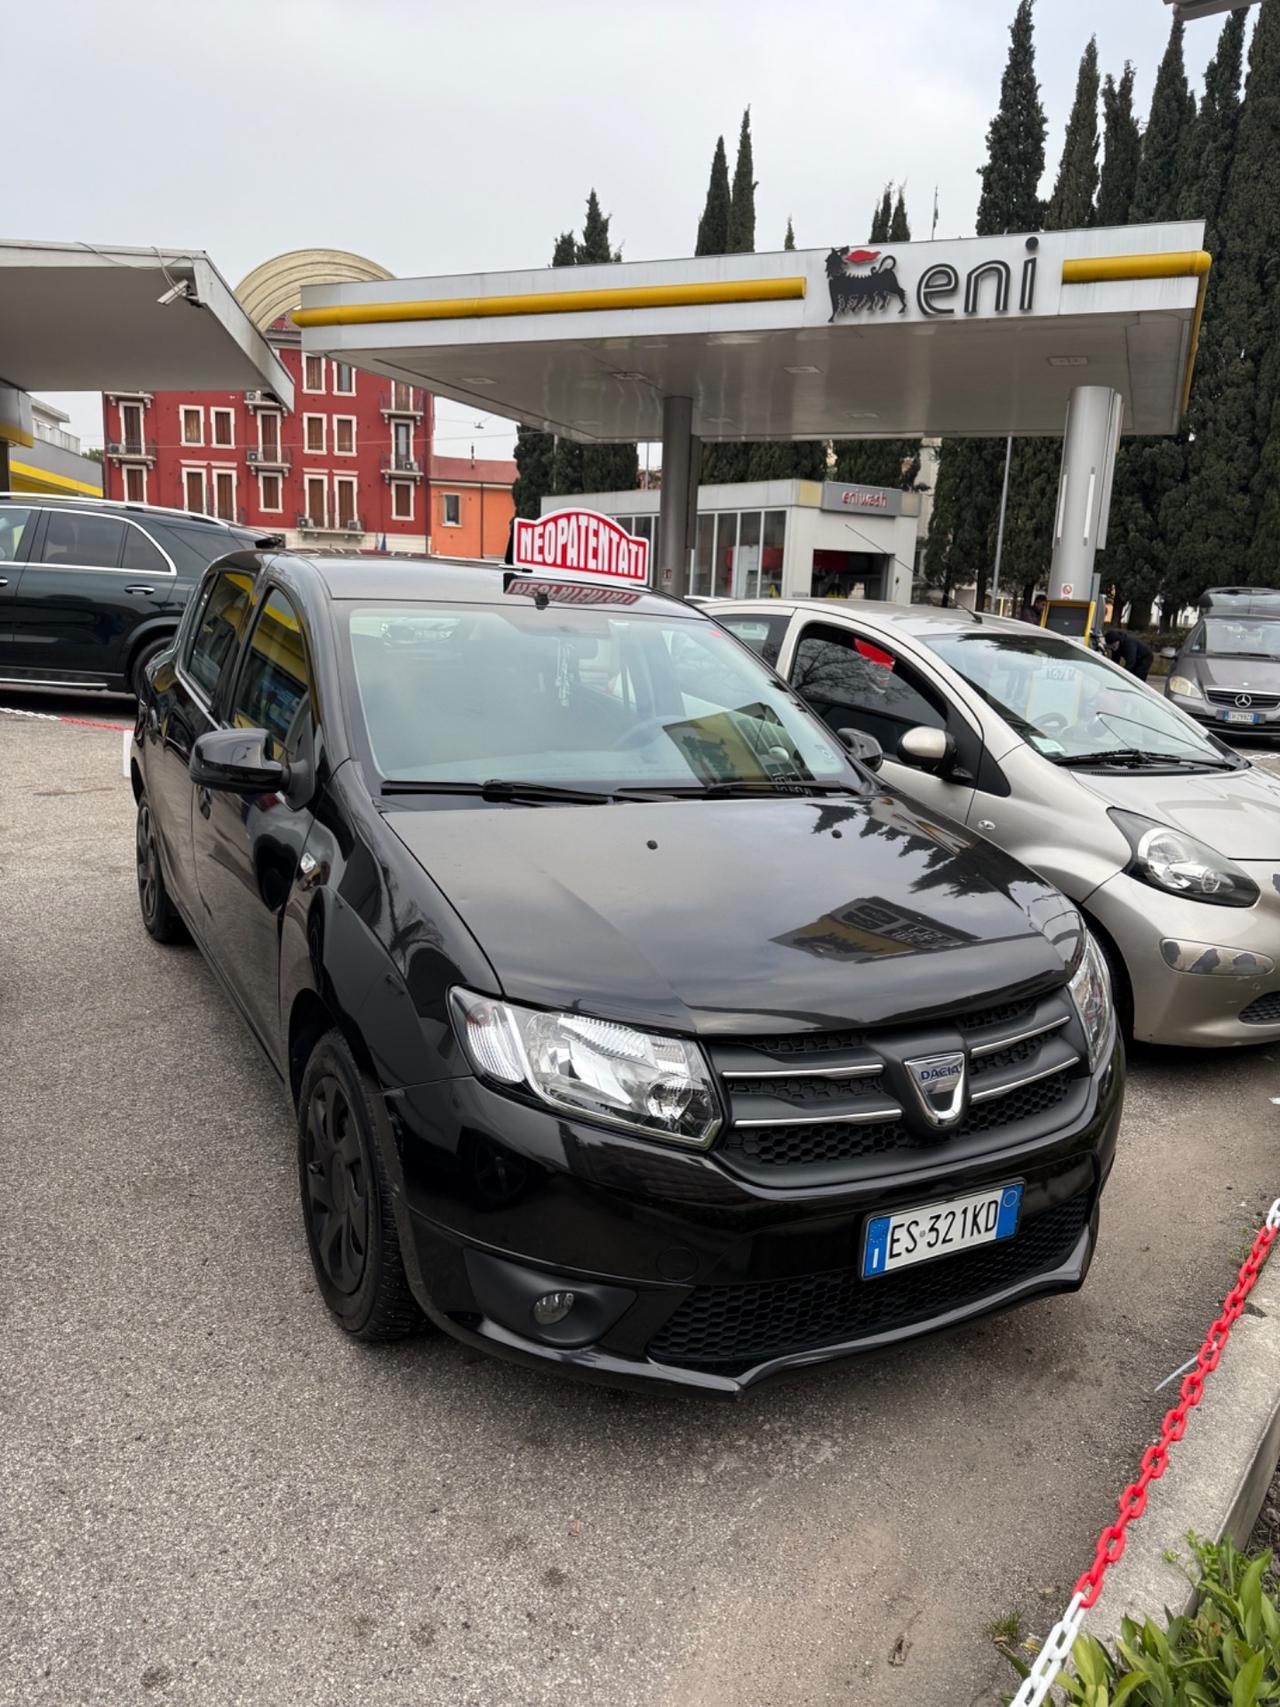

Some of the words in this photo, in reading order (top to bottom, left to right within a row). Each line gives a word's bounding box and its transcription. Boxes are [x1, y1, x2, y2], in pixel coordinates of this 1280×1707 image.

[917, 236, 1039, 315] eni
[519, 513, 644, 577] NEOPATENTATI
[920, 1065, 961, 1080] DACIA
